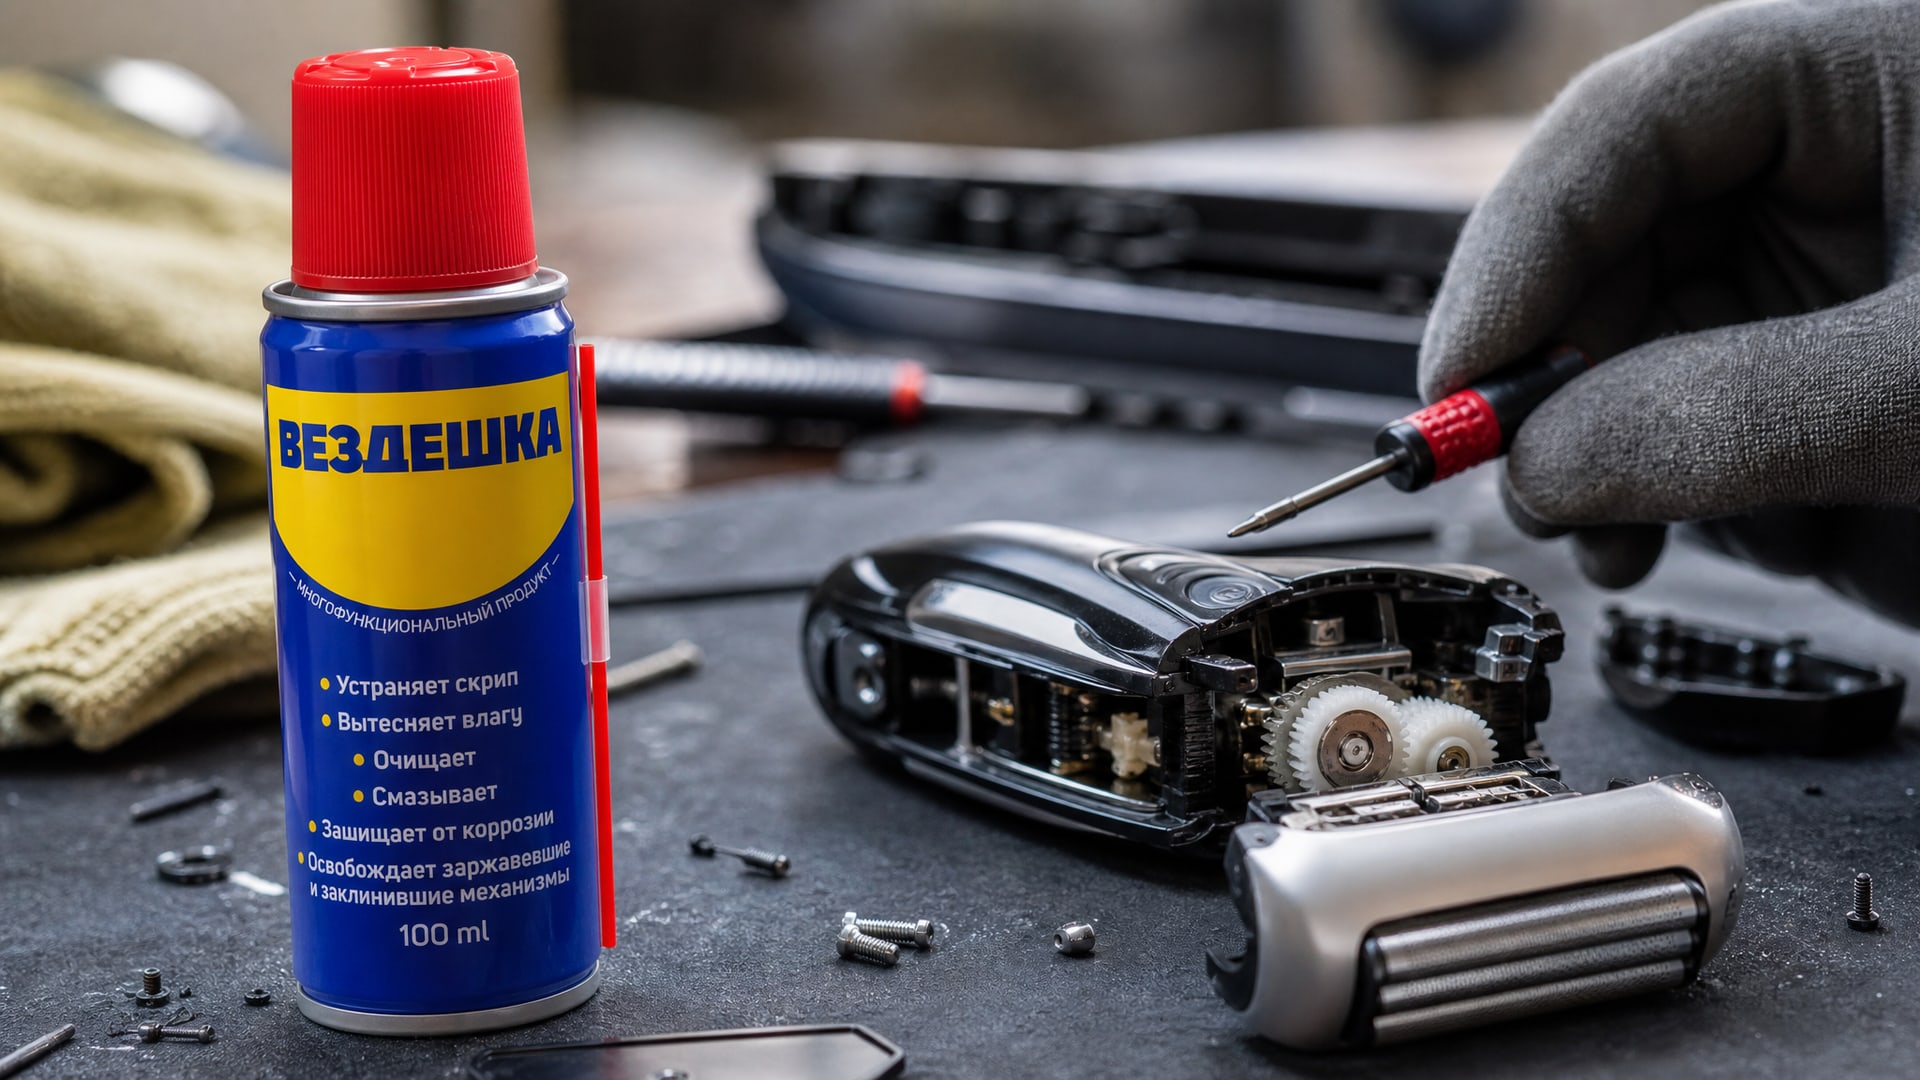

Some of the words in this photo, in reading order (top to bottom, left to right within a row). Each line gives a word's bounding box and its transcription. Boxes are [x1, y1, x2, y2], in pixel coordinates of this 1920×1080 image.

[278, 407, 562, 473] ВЕЗДЕШКА
[336, 675, 449, 700] Устраняет
[455, 670, 518, 695] скрип
[338, 711, 456, 732] Вытесняет
[463, 707, 522, 728] влагу
[374, 750, 476, 771] Очищает
[372, 785, 498, 806] Смазывает
[433, 825, 457, 842] от
[463, 809, 554, 841] коррозии
[308, 852, 436, 883] Освобождает
[442, 840, 571, 880] заржавевшие
[310, 881, 318, 897] и
[321, 883, 454, 906] заклинившие
[460, 868, 570, 903] механизмы
[399, 923, 449, 947] 100
[457, 919, 490, 945] ml
